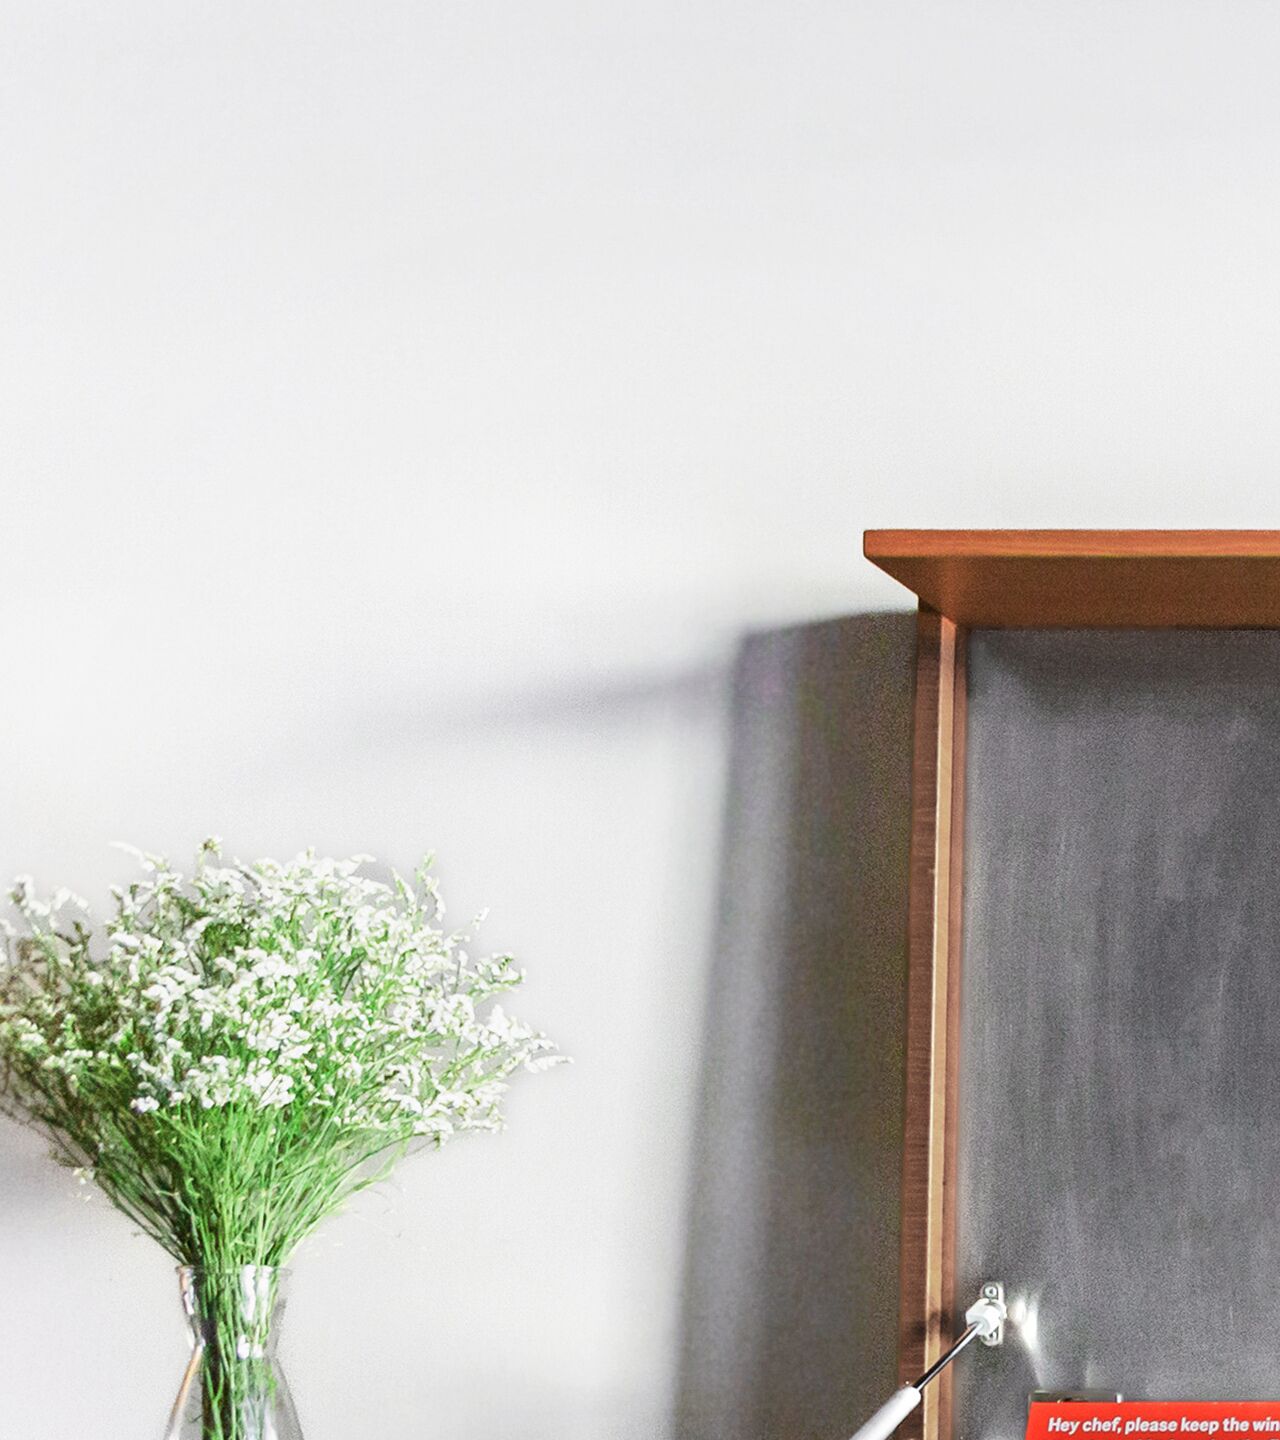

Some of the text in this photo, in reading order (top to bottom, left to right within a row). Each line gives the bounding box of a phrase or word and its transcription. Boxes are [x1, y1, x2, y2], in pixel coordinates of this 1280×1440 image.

[1047, 1417, 1080, 1435] Hey
[1082, 1417, 1123, 1434] chef,
[1124, 1417, 1178, 1435] please
[1180, 1417, 1219, 1435] keep
[1222, 1417, 1249, 1432] the
